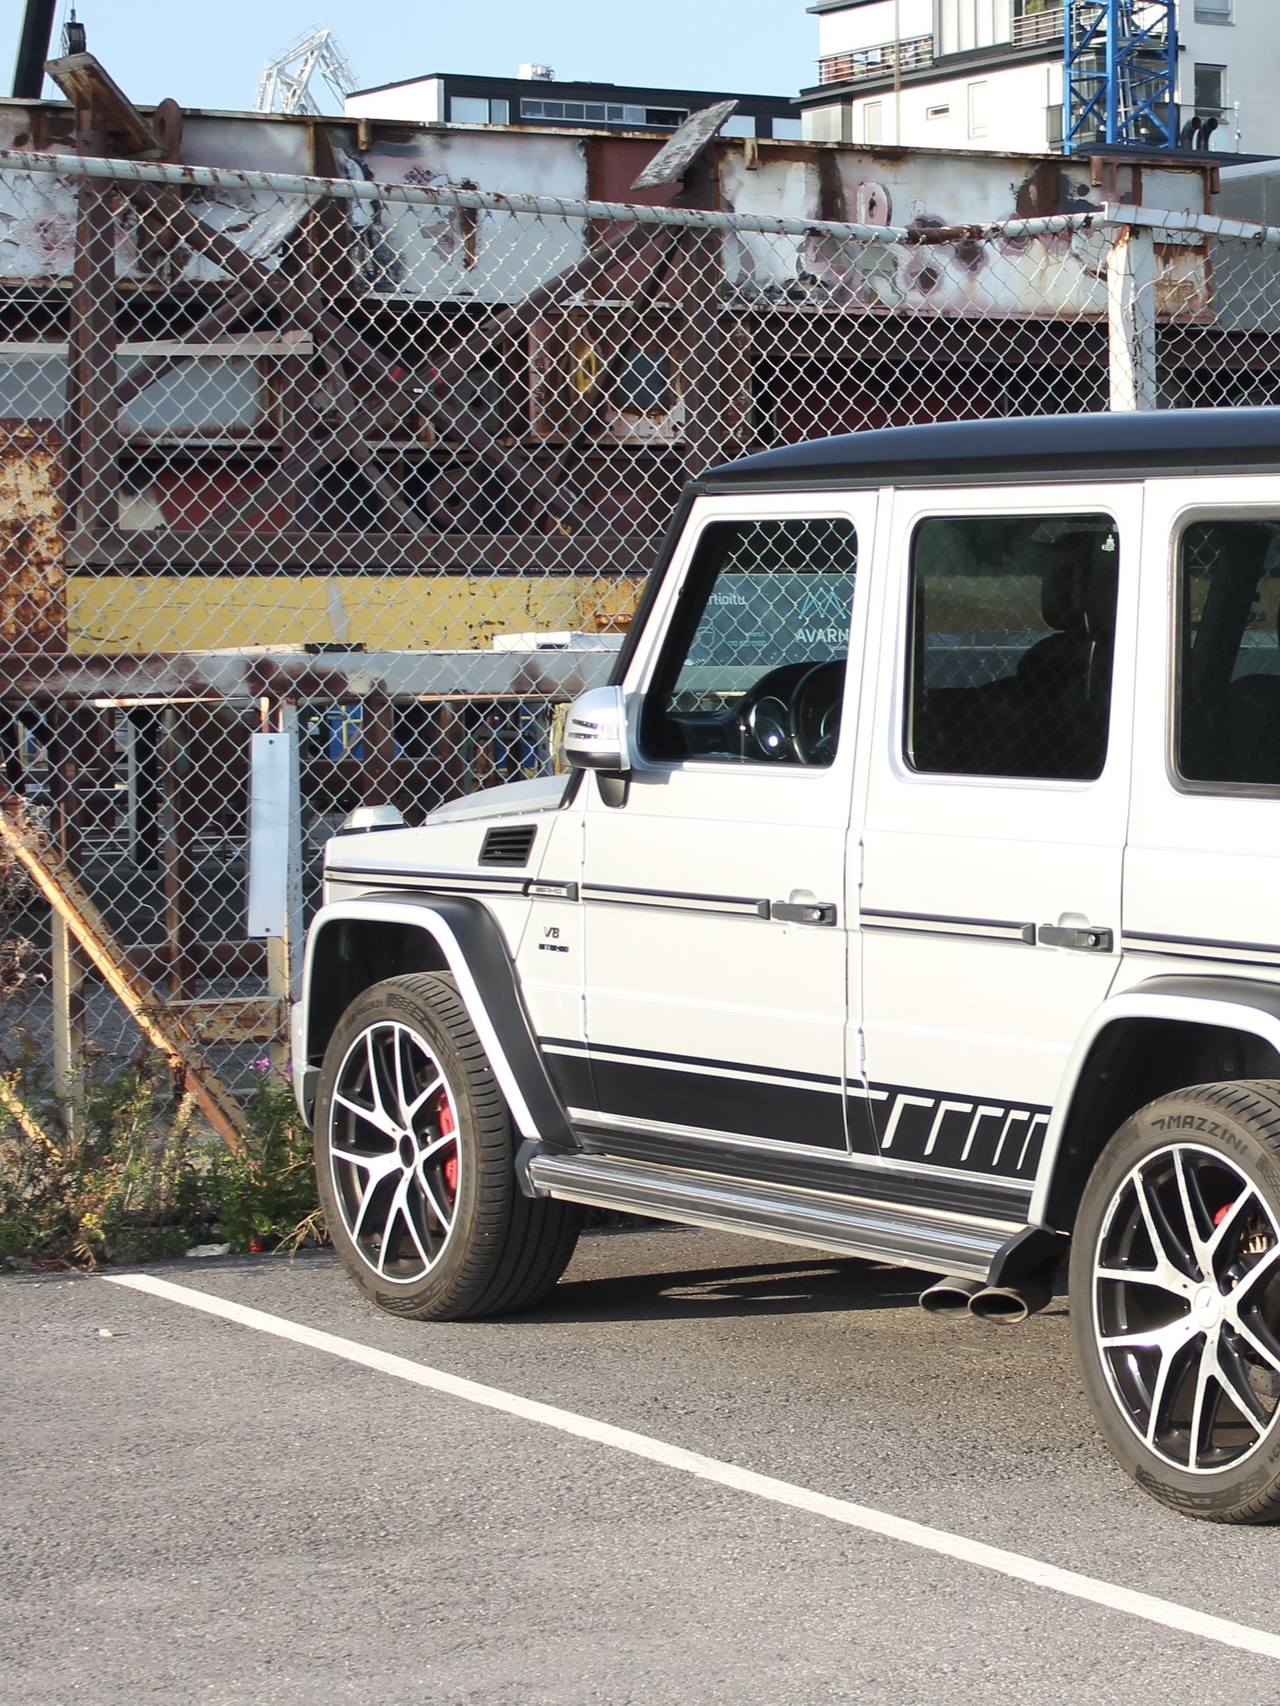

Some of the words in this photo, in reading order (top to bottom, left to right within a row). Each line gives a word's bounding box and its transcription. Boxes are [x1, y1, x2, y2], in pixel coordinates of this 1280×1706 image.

[706, 592, 745, 605] rtioitu
[795, 628, 849, 643] AVARN
[543, 926, 560, 938] V8
[1166, 1115, 1249, 1155] MAZZINI
